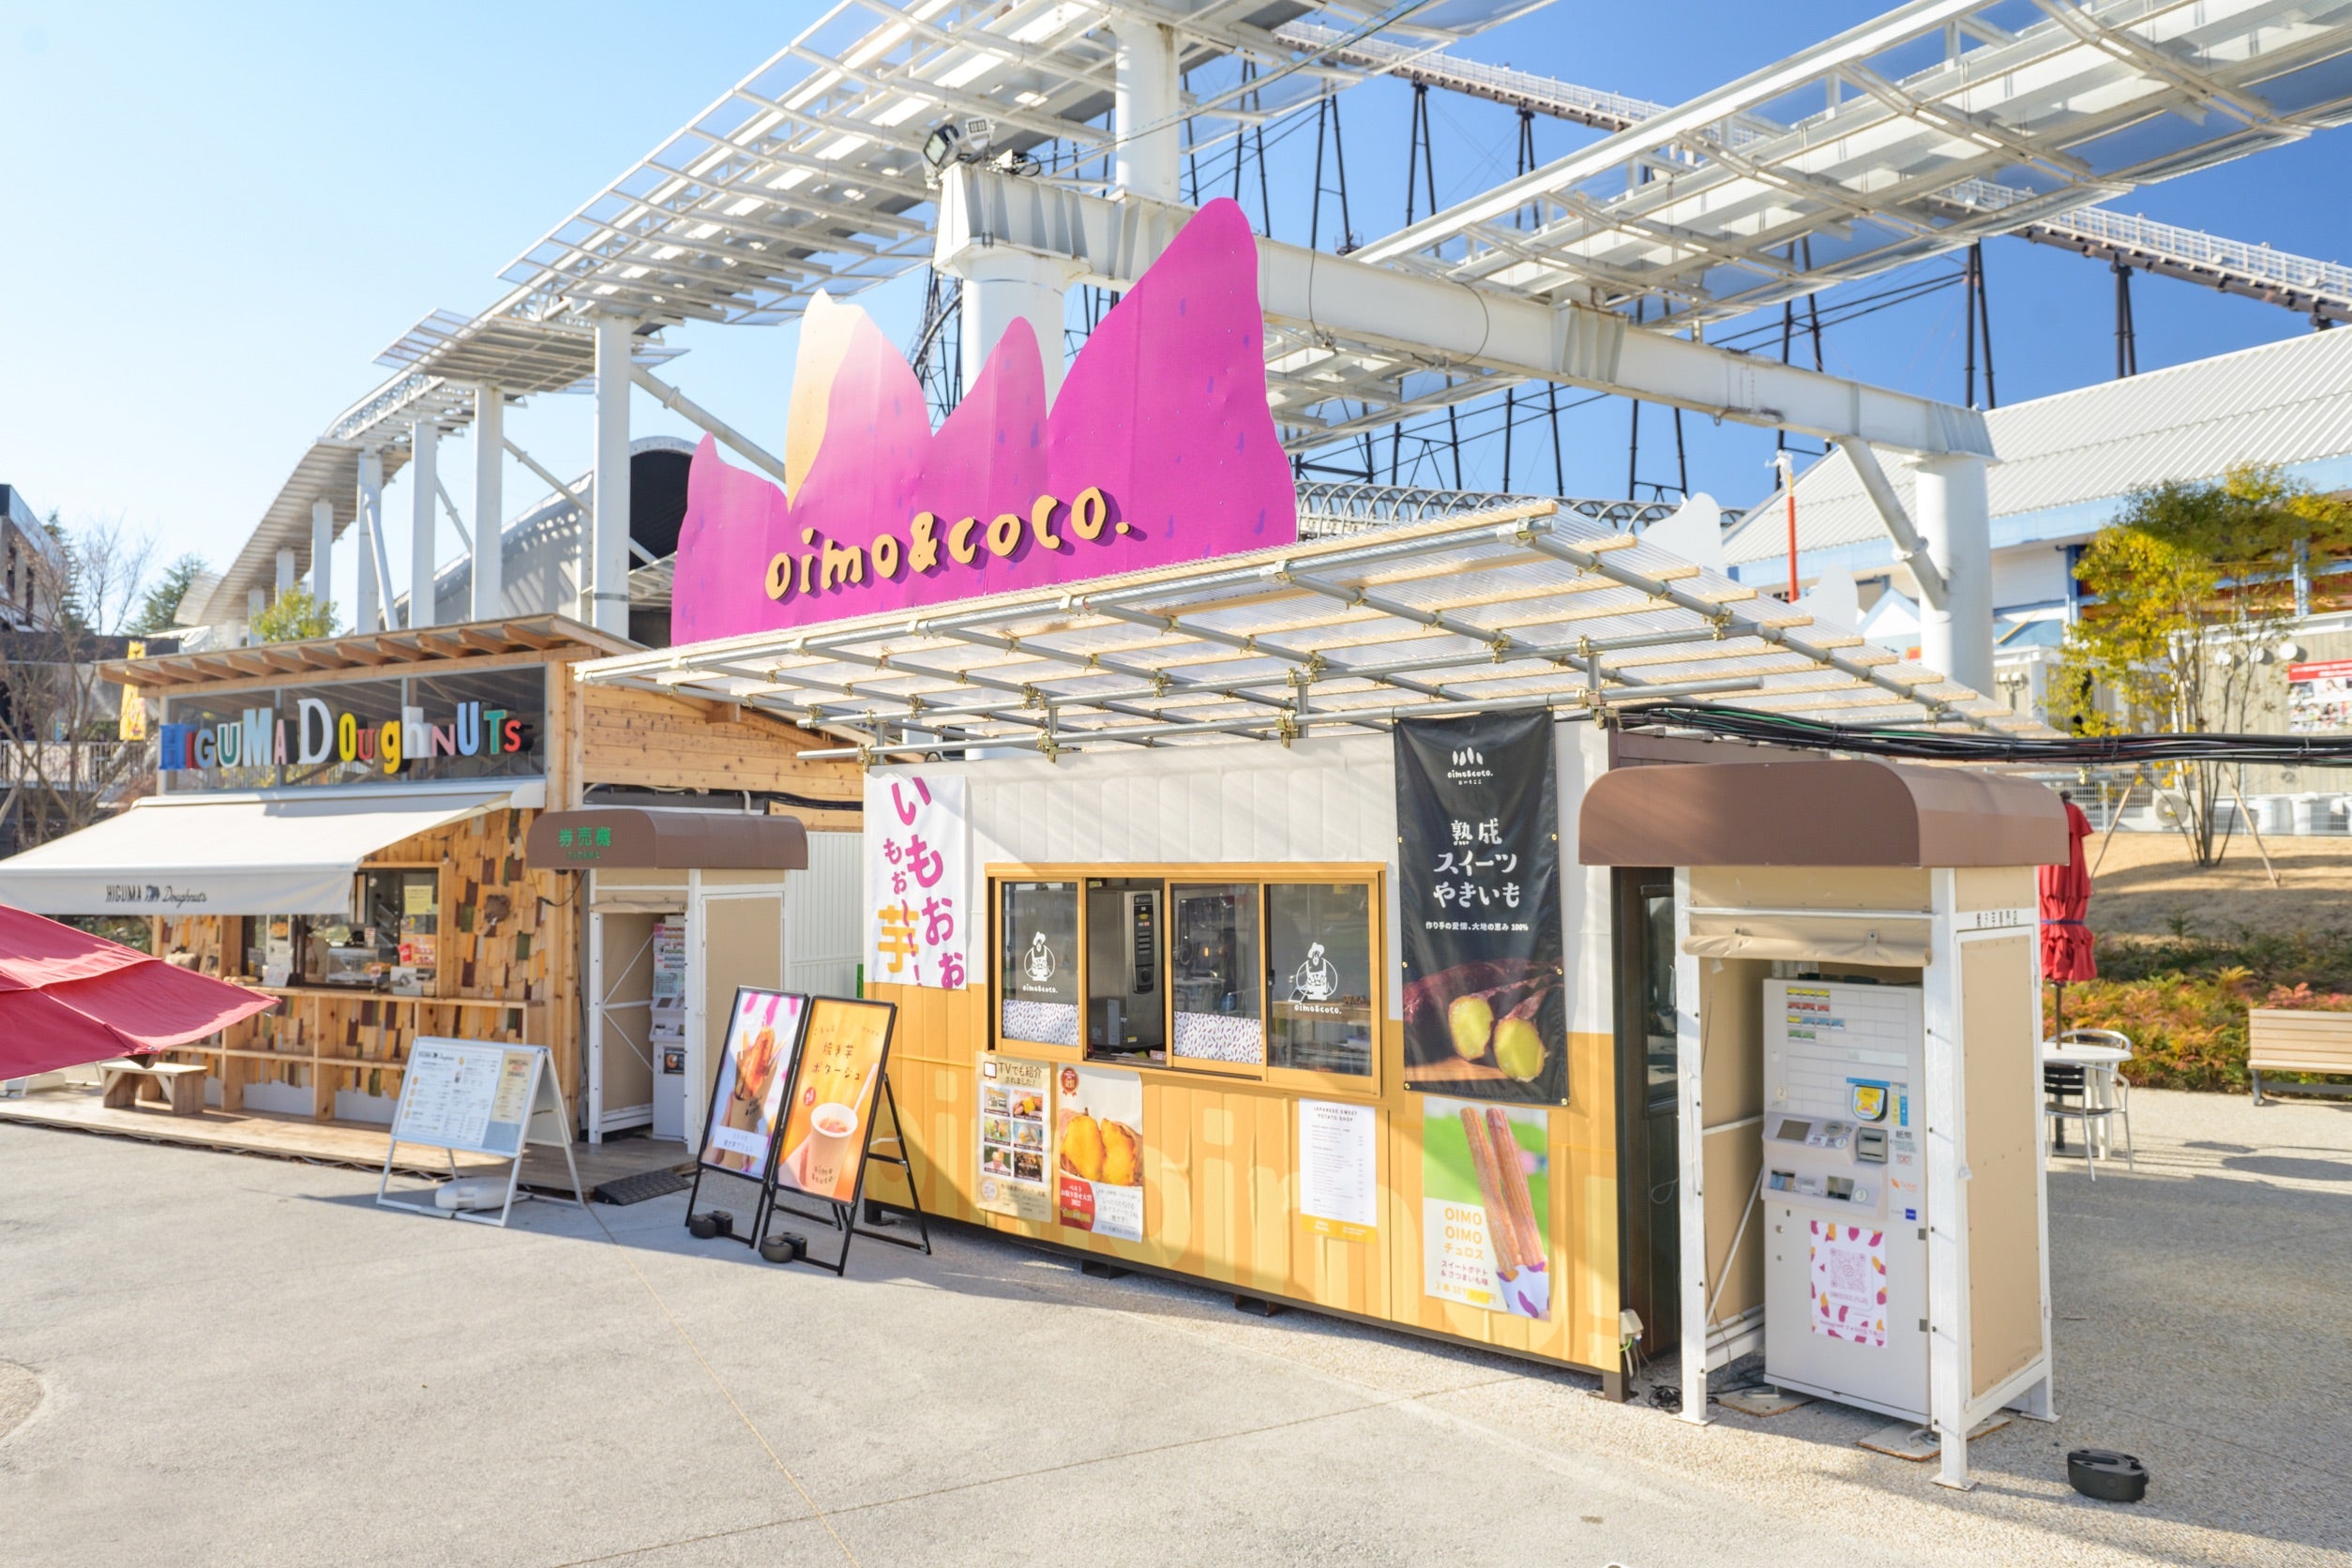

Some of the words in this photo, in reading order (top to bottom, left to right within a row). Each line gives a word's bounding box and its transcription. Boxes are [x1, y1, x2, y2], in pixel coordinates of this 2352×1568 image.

[764, 486, 1130, 601] oimo&coco.
[158, 707, 287, 771] HIGUMA
[1451, 818, 1502, 846] 熟成
[1433, 850, 1517, 876] スイーツ
[106, 884, 142, 901] HIGUMA
[1433, 882, 1519, 908] やきいも
[1444, 1207, 1483, 1227] OIMO
[1445, 1226, 1483, 1245] OIMO
[1444, 1243, 1485, 1260] チュロス
